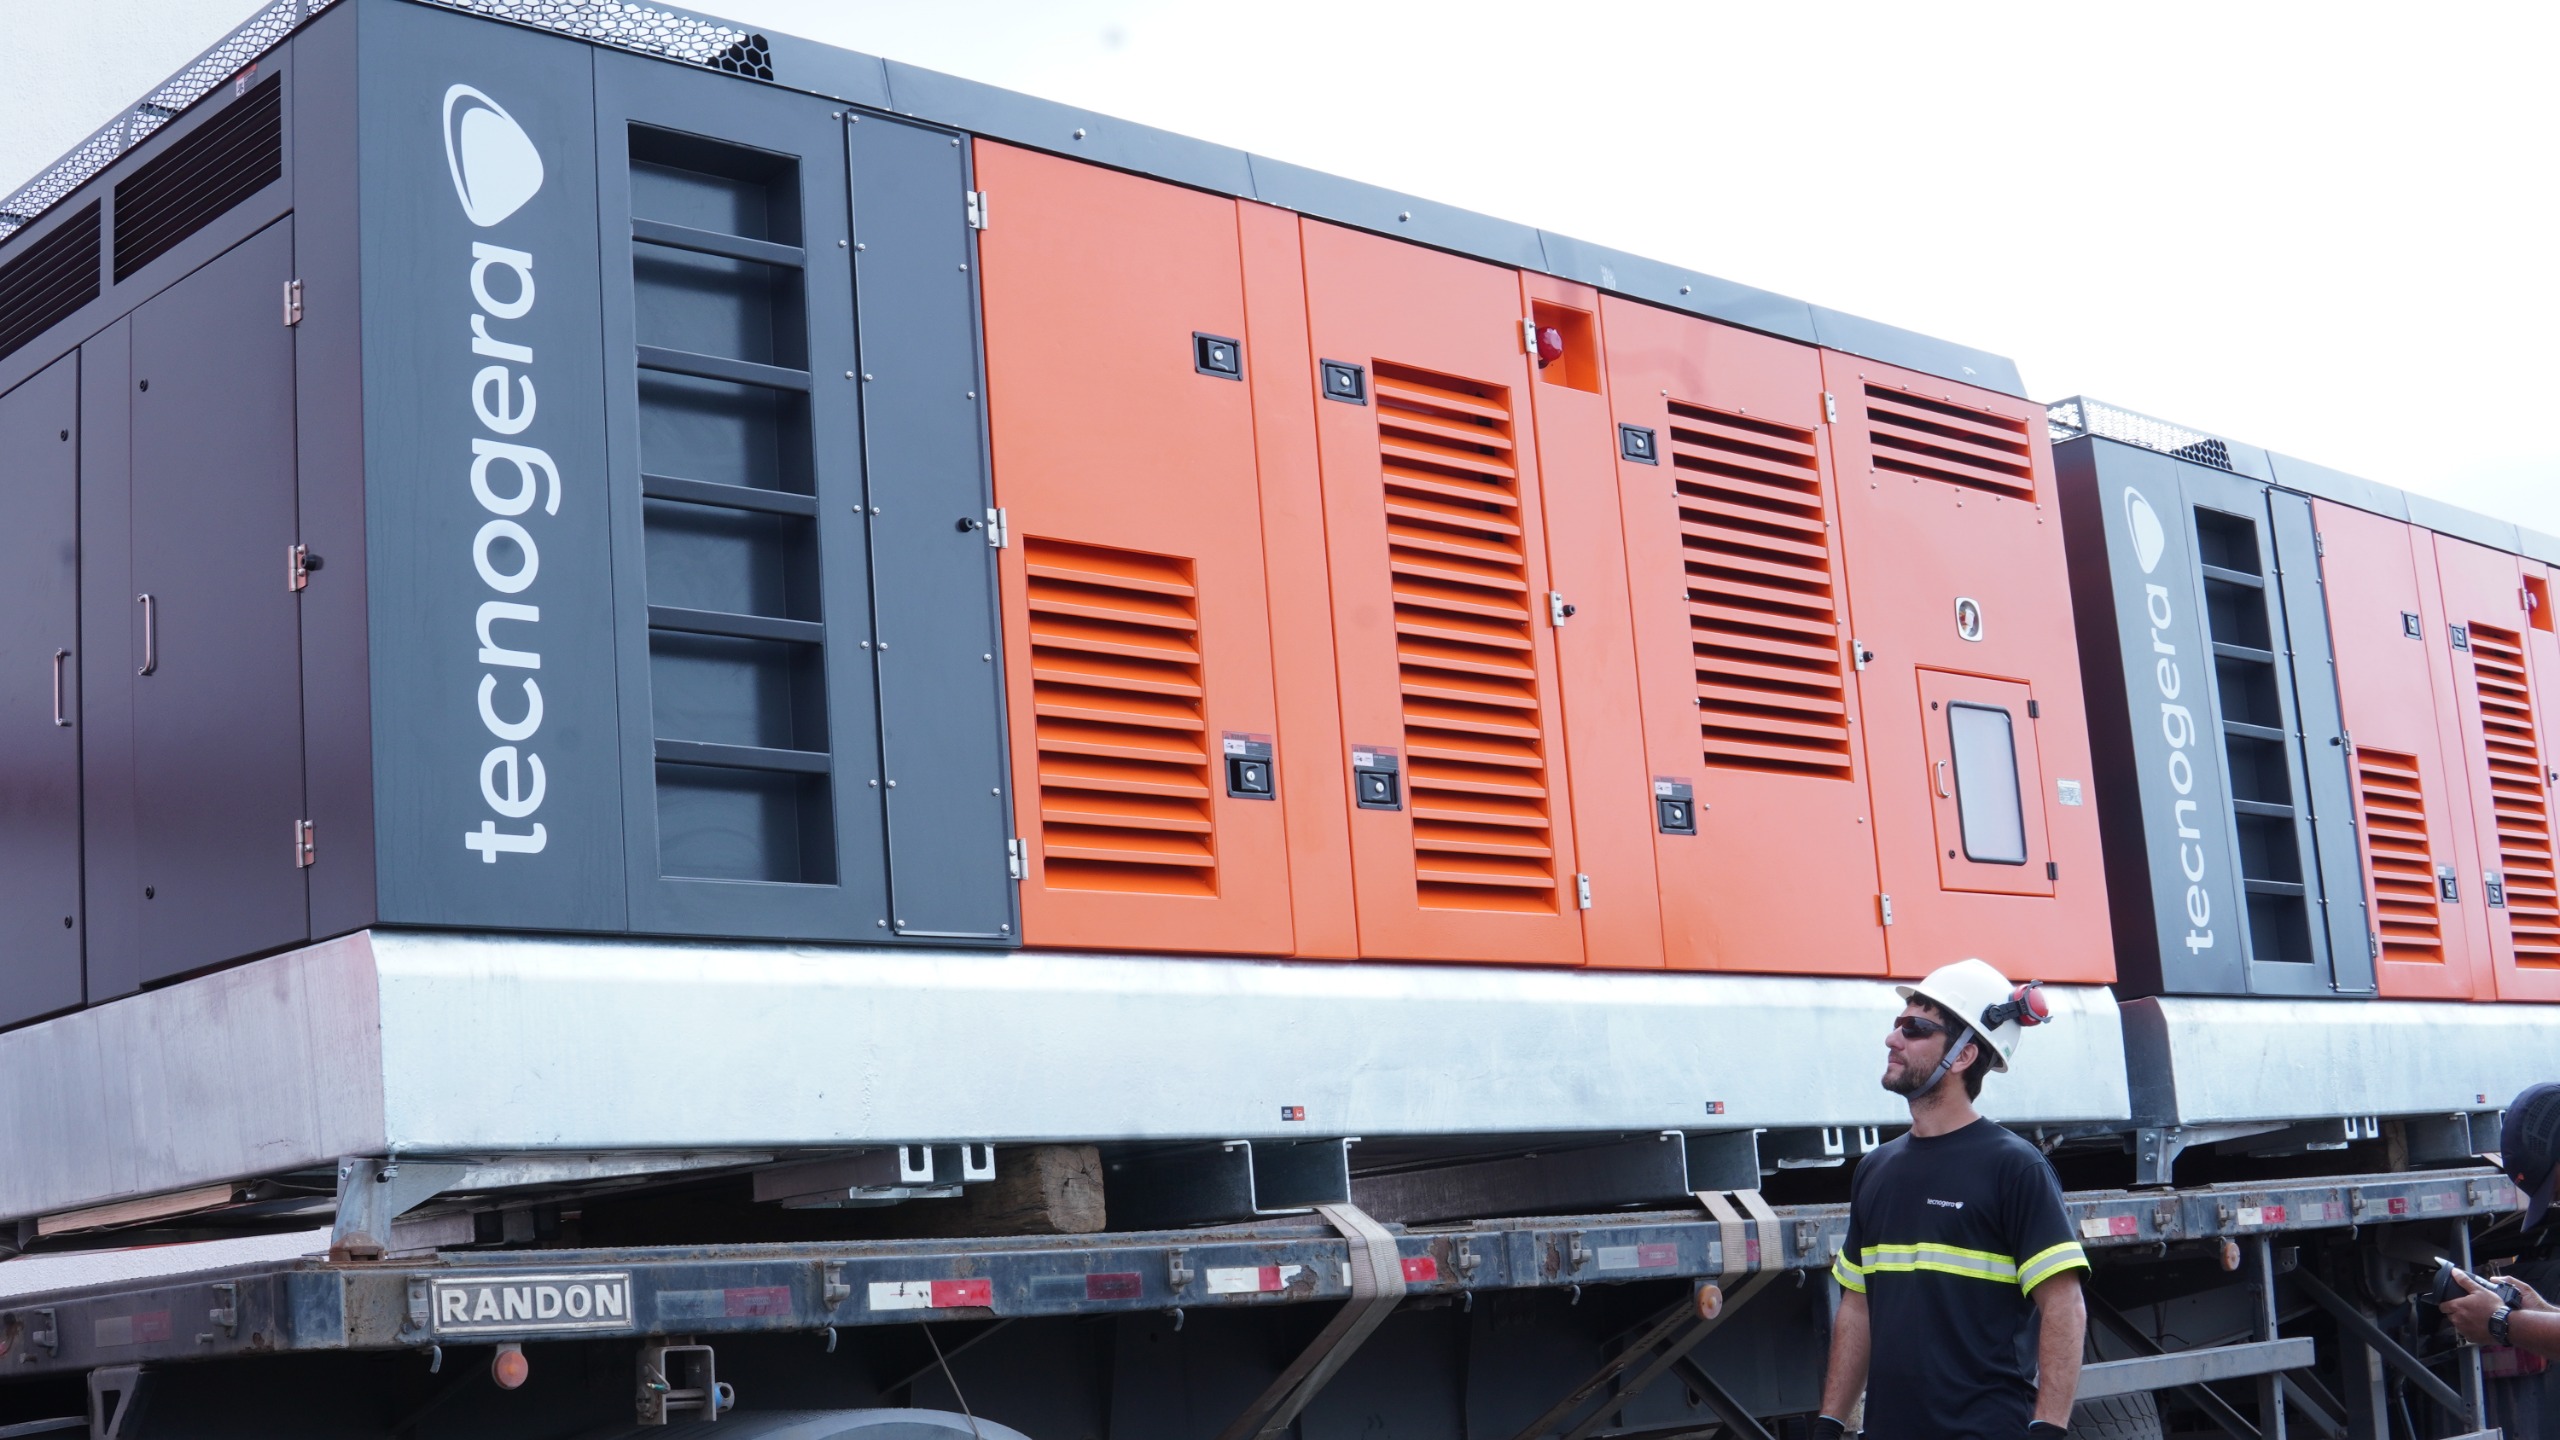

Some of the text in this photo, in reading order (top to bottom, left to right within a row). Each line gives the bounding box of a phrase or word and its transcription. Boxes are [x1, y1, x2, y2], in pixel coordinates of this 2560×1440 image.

[465, 241, 562, 864] tecnogera
[2145, 583, 2214, 956] tecnogera
[441, 1284, 623, 1322] RANDON
[1927, 1198, 1956, 1208] tecnogera
